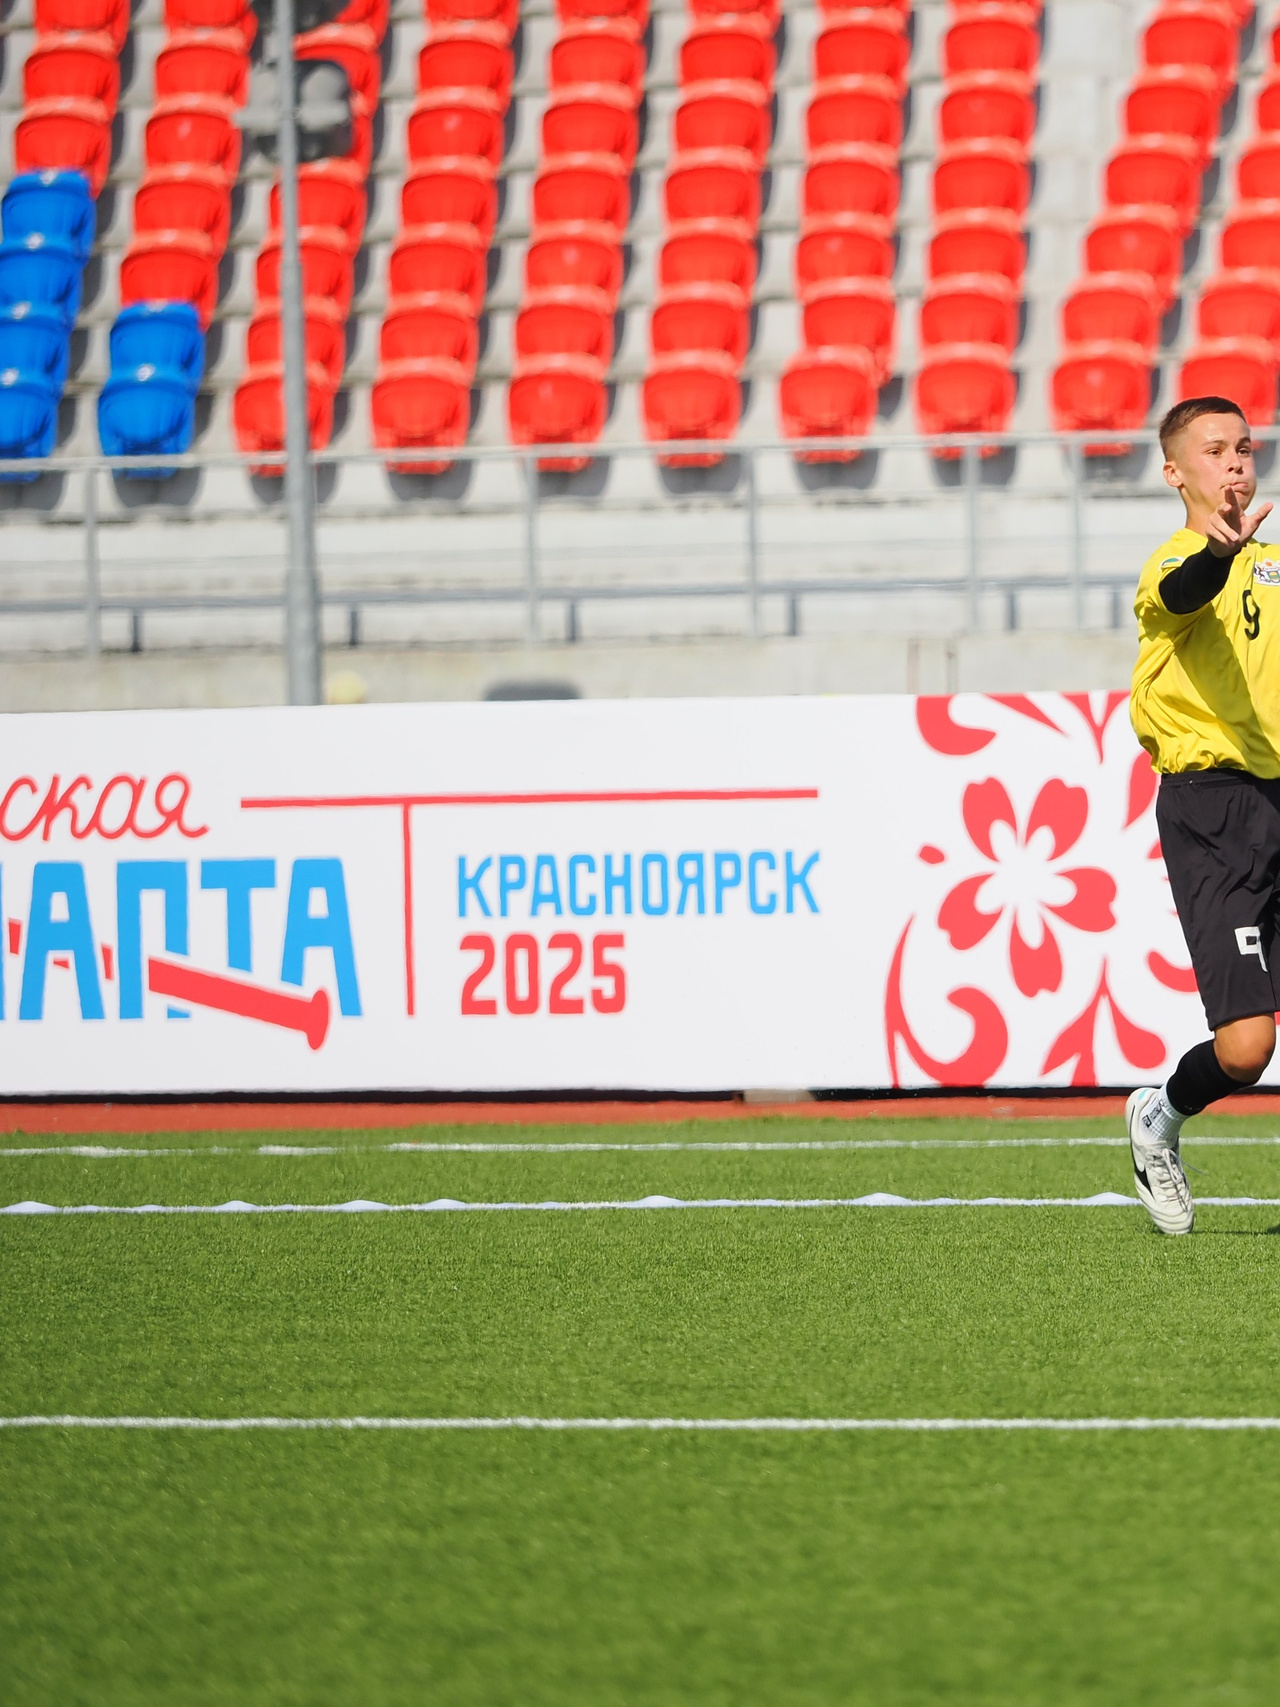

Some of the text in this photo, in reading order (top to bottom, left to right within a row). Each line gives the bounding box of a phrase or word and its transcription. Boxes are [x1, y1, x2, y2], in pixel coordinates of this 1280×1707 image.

[1242, 589, 1260, 640] 9
[458, 850, 821, 919] КРАСНОЯРСК
[0, 858, 363, 1020] АПТА
[1234, 926, 1268, 973] 9
[460, 932, 628, 1016] 2025
